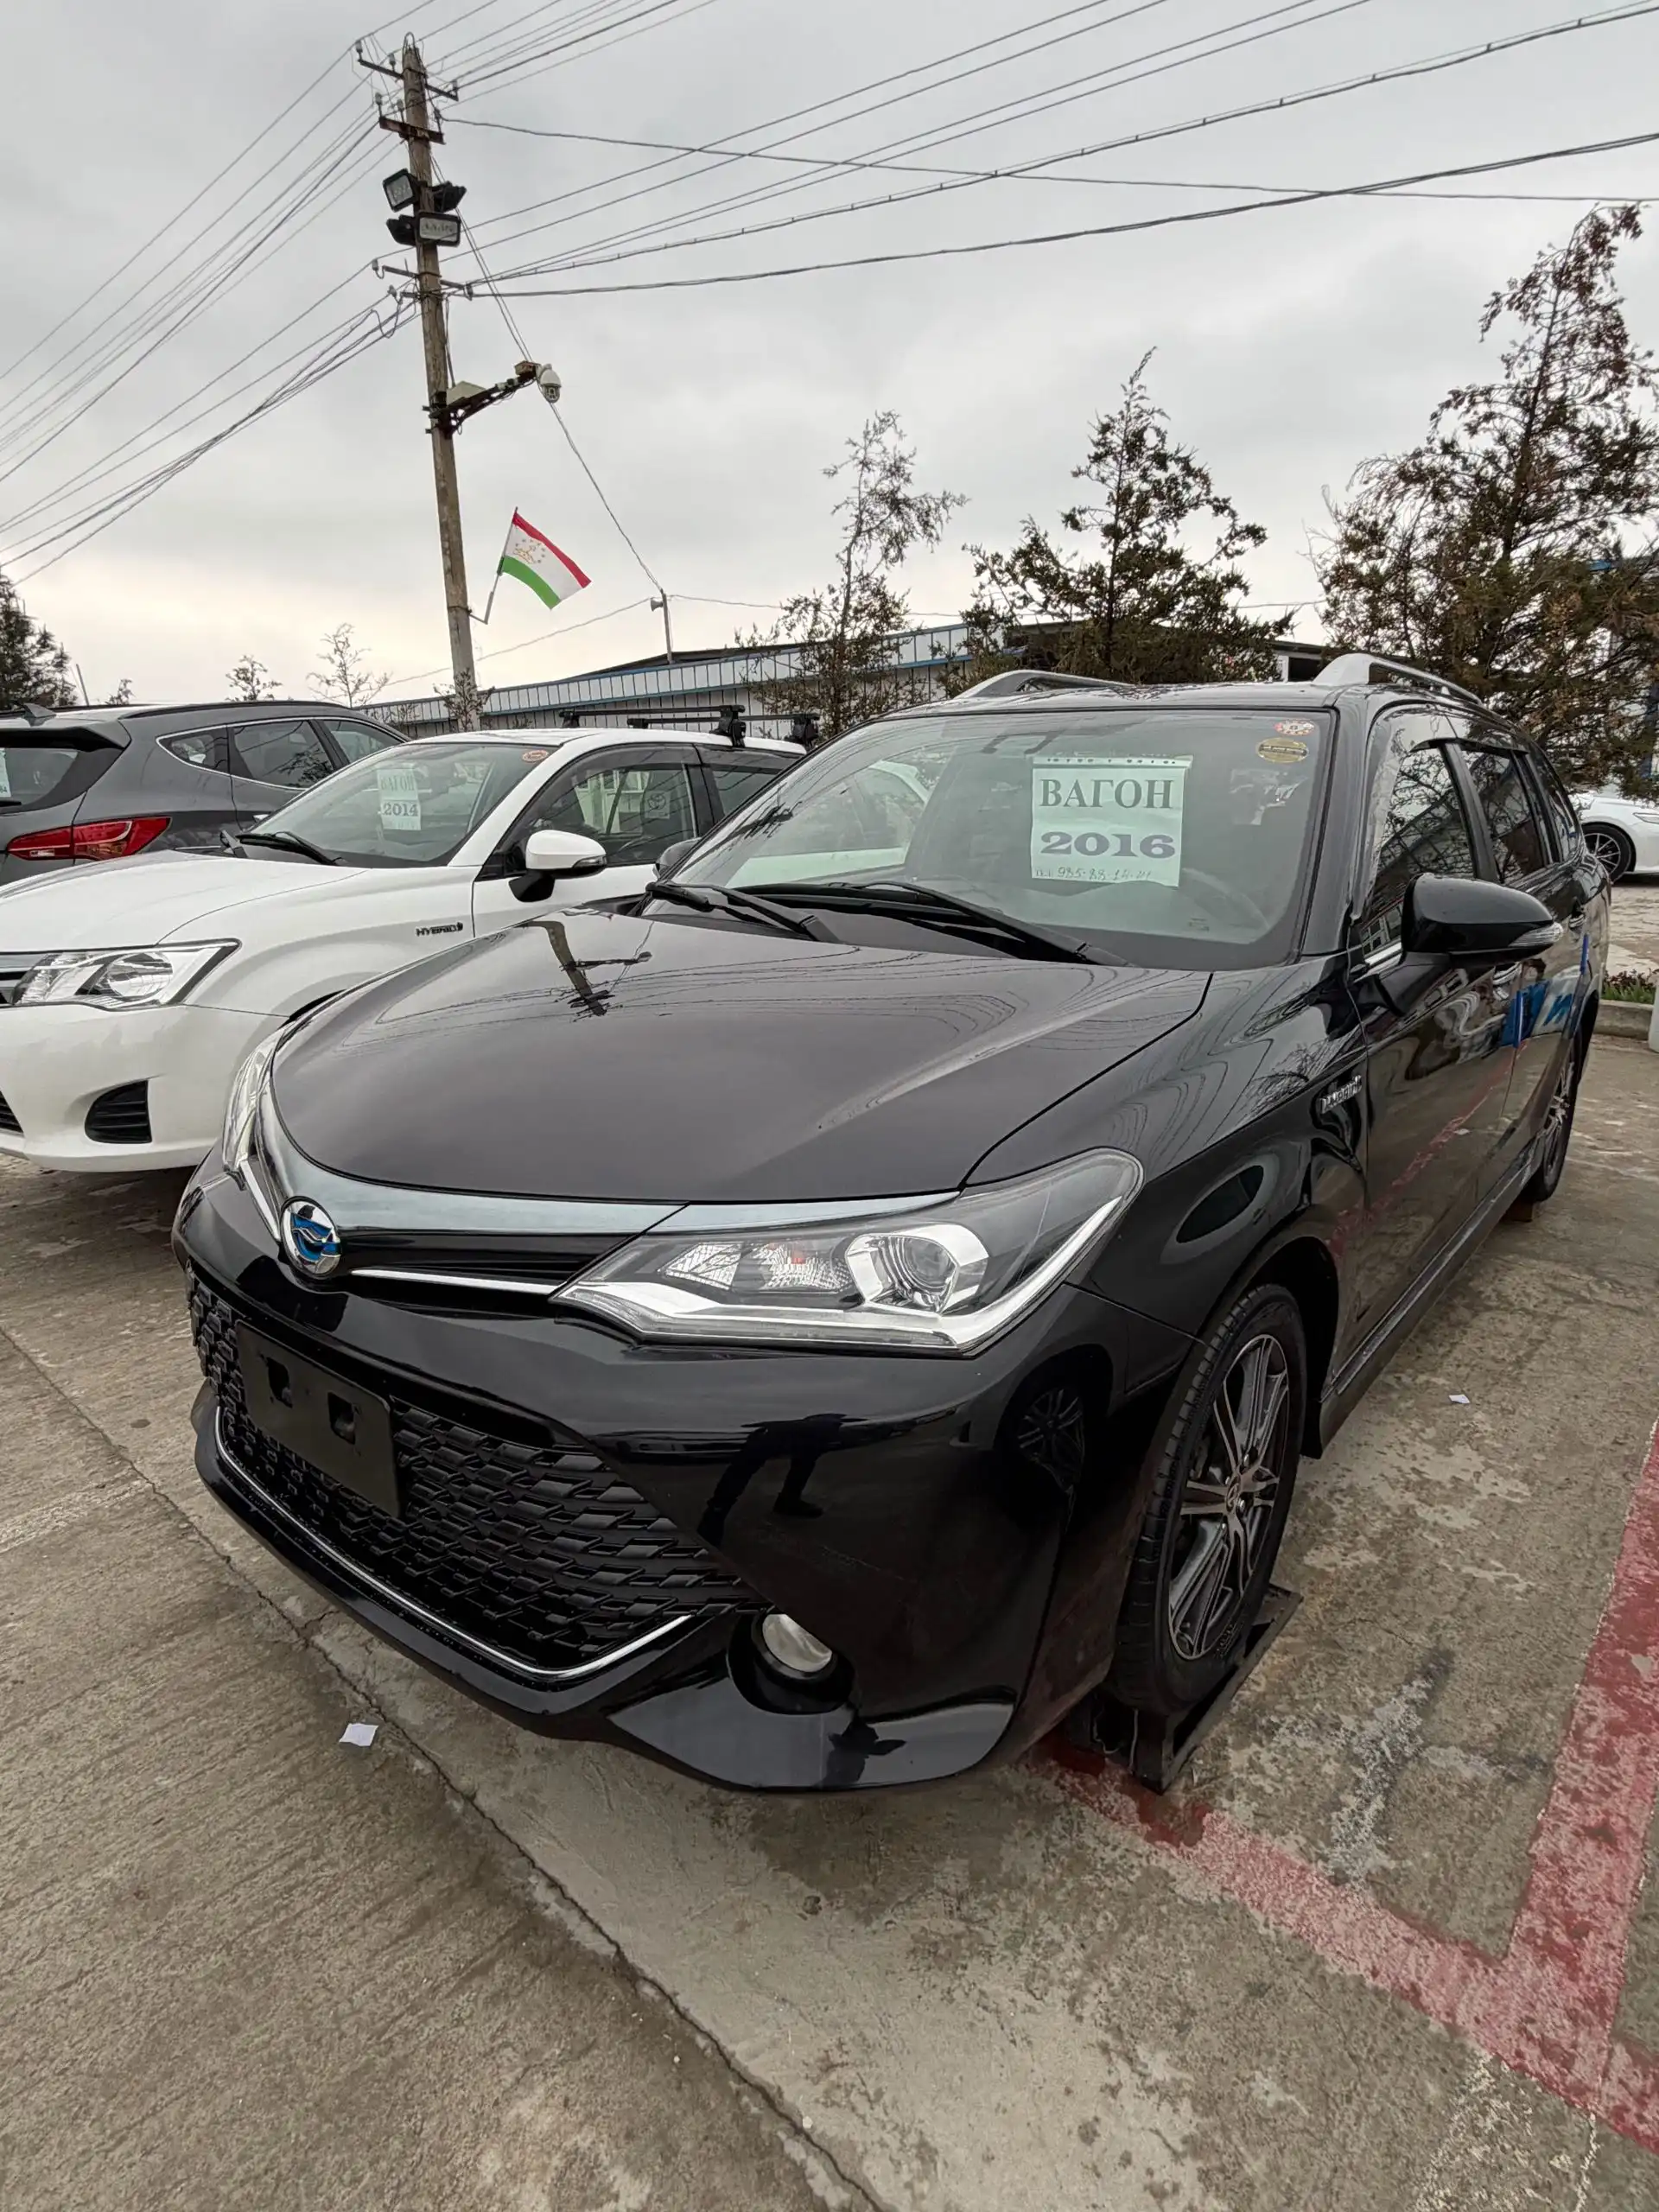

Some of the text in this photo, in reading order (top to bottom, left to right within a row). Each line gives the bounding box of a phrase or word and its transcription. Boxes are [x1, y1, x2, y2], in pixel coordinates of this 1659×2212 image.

[1039, 779, 1173, 809] ВАГОН
[383, 802, 418, 817] 2014
[1040, 831, 1175, 859] 2016
